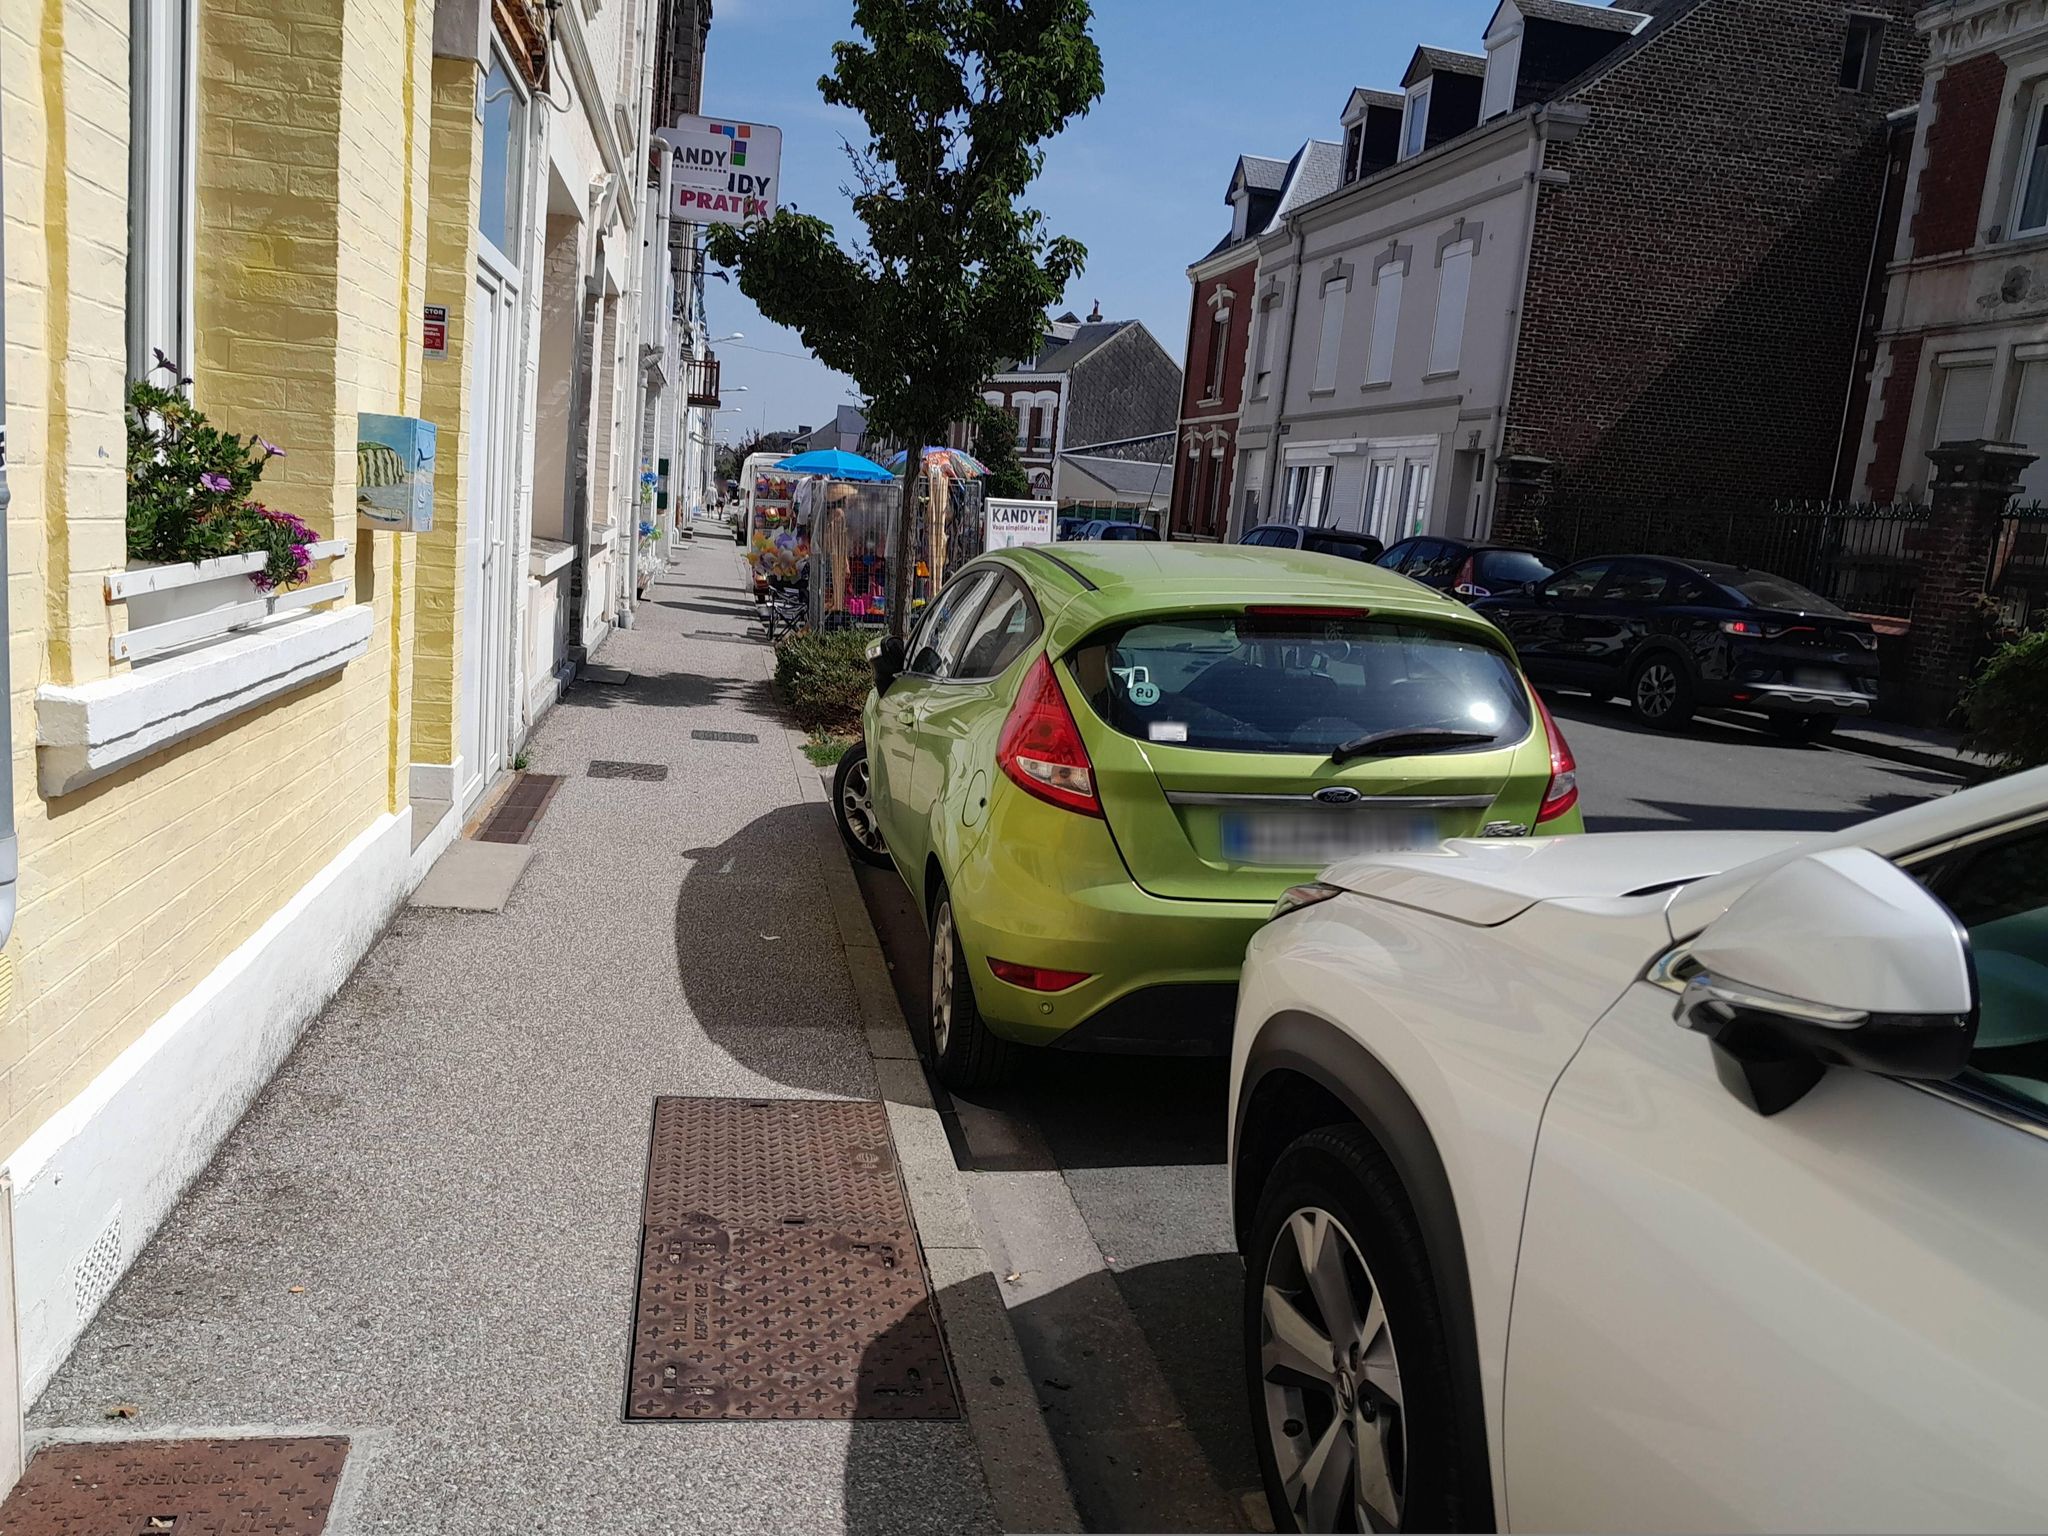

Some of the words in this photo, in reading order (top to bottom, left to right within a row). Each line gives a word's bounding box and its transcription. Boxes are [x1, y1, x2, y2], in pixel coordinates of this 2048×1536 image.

[672, 145, 728, 167] ANDY
[424, 308, 444, 316] CTOR
[992, 508, 1037, 523] KANDY
[1005, 524, 1030, 532] simplifier
[1323, 791, 1352, 802] Ford
